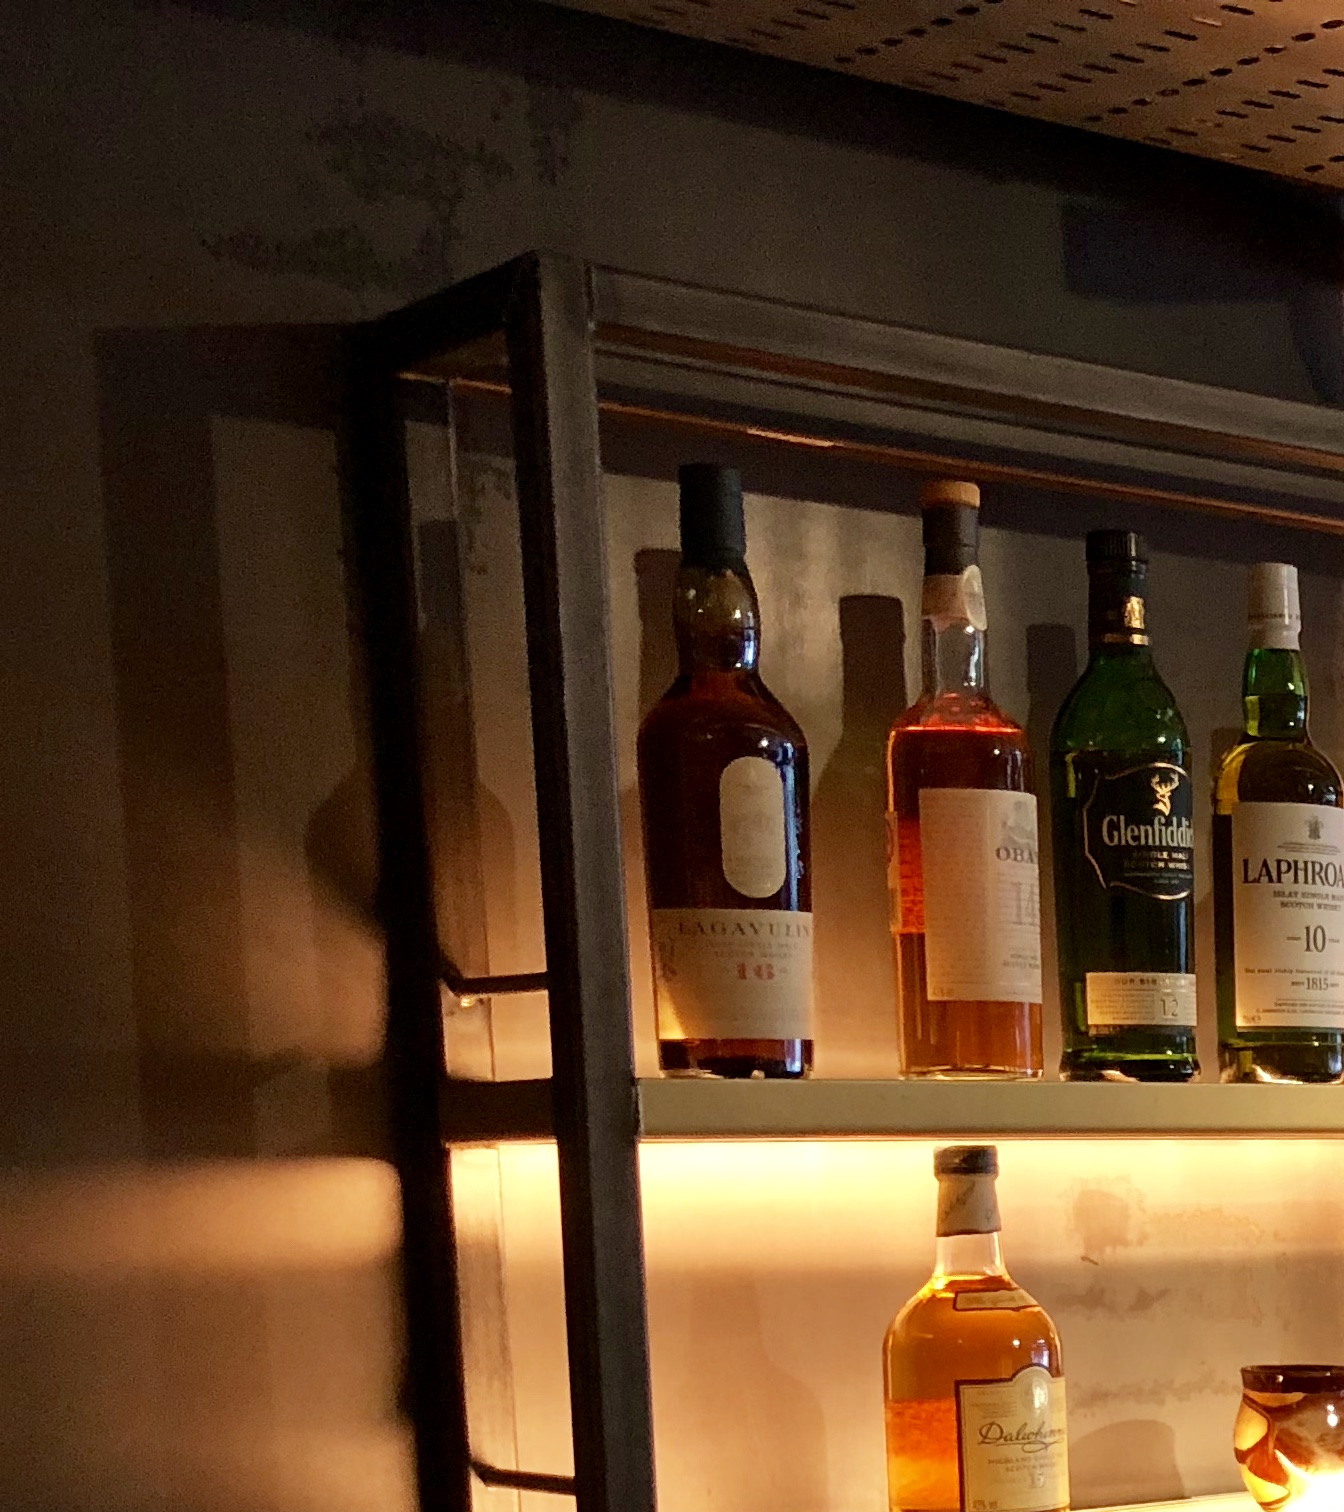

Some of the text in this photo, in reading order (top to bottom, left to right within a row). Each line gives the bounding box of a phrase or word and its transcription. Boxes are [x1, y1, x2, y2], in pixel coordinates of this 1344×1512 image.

[996, 846, 1039, 865] OBA
[1304, 924, 1327, 953] 10
[735, 963, 776, 981] 16
[1305, 976, 1329, 991] 1815
[1162, 998, 1179, 1017] 12
